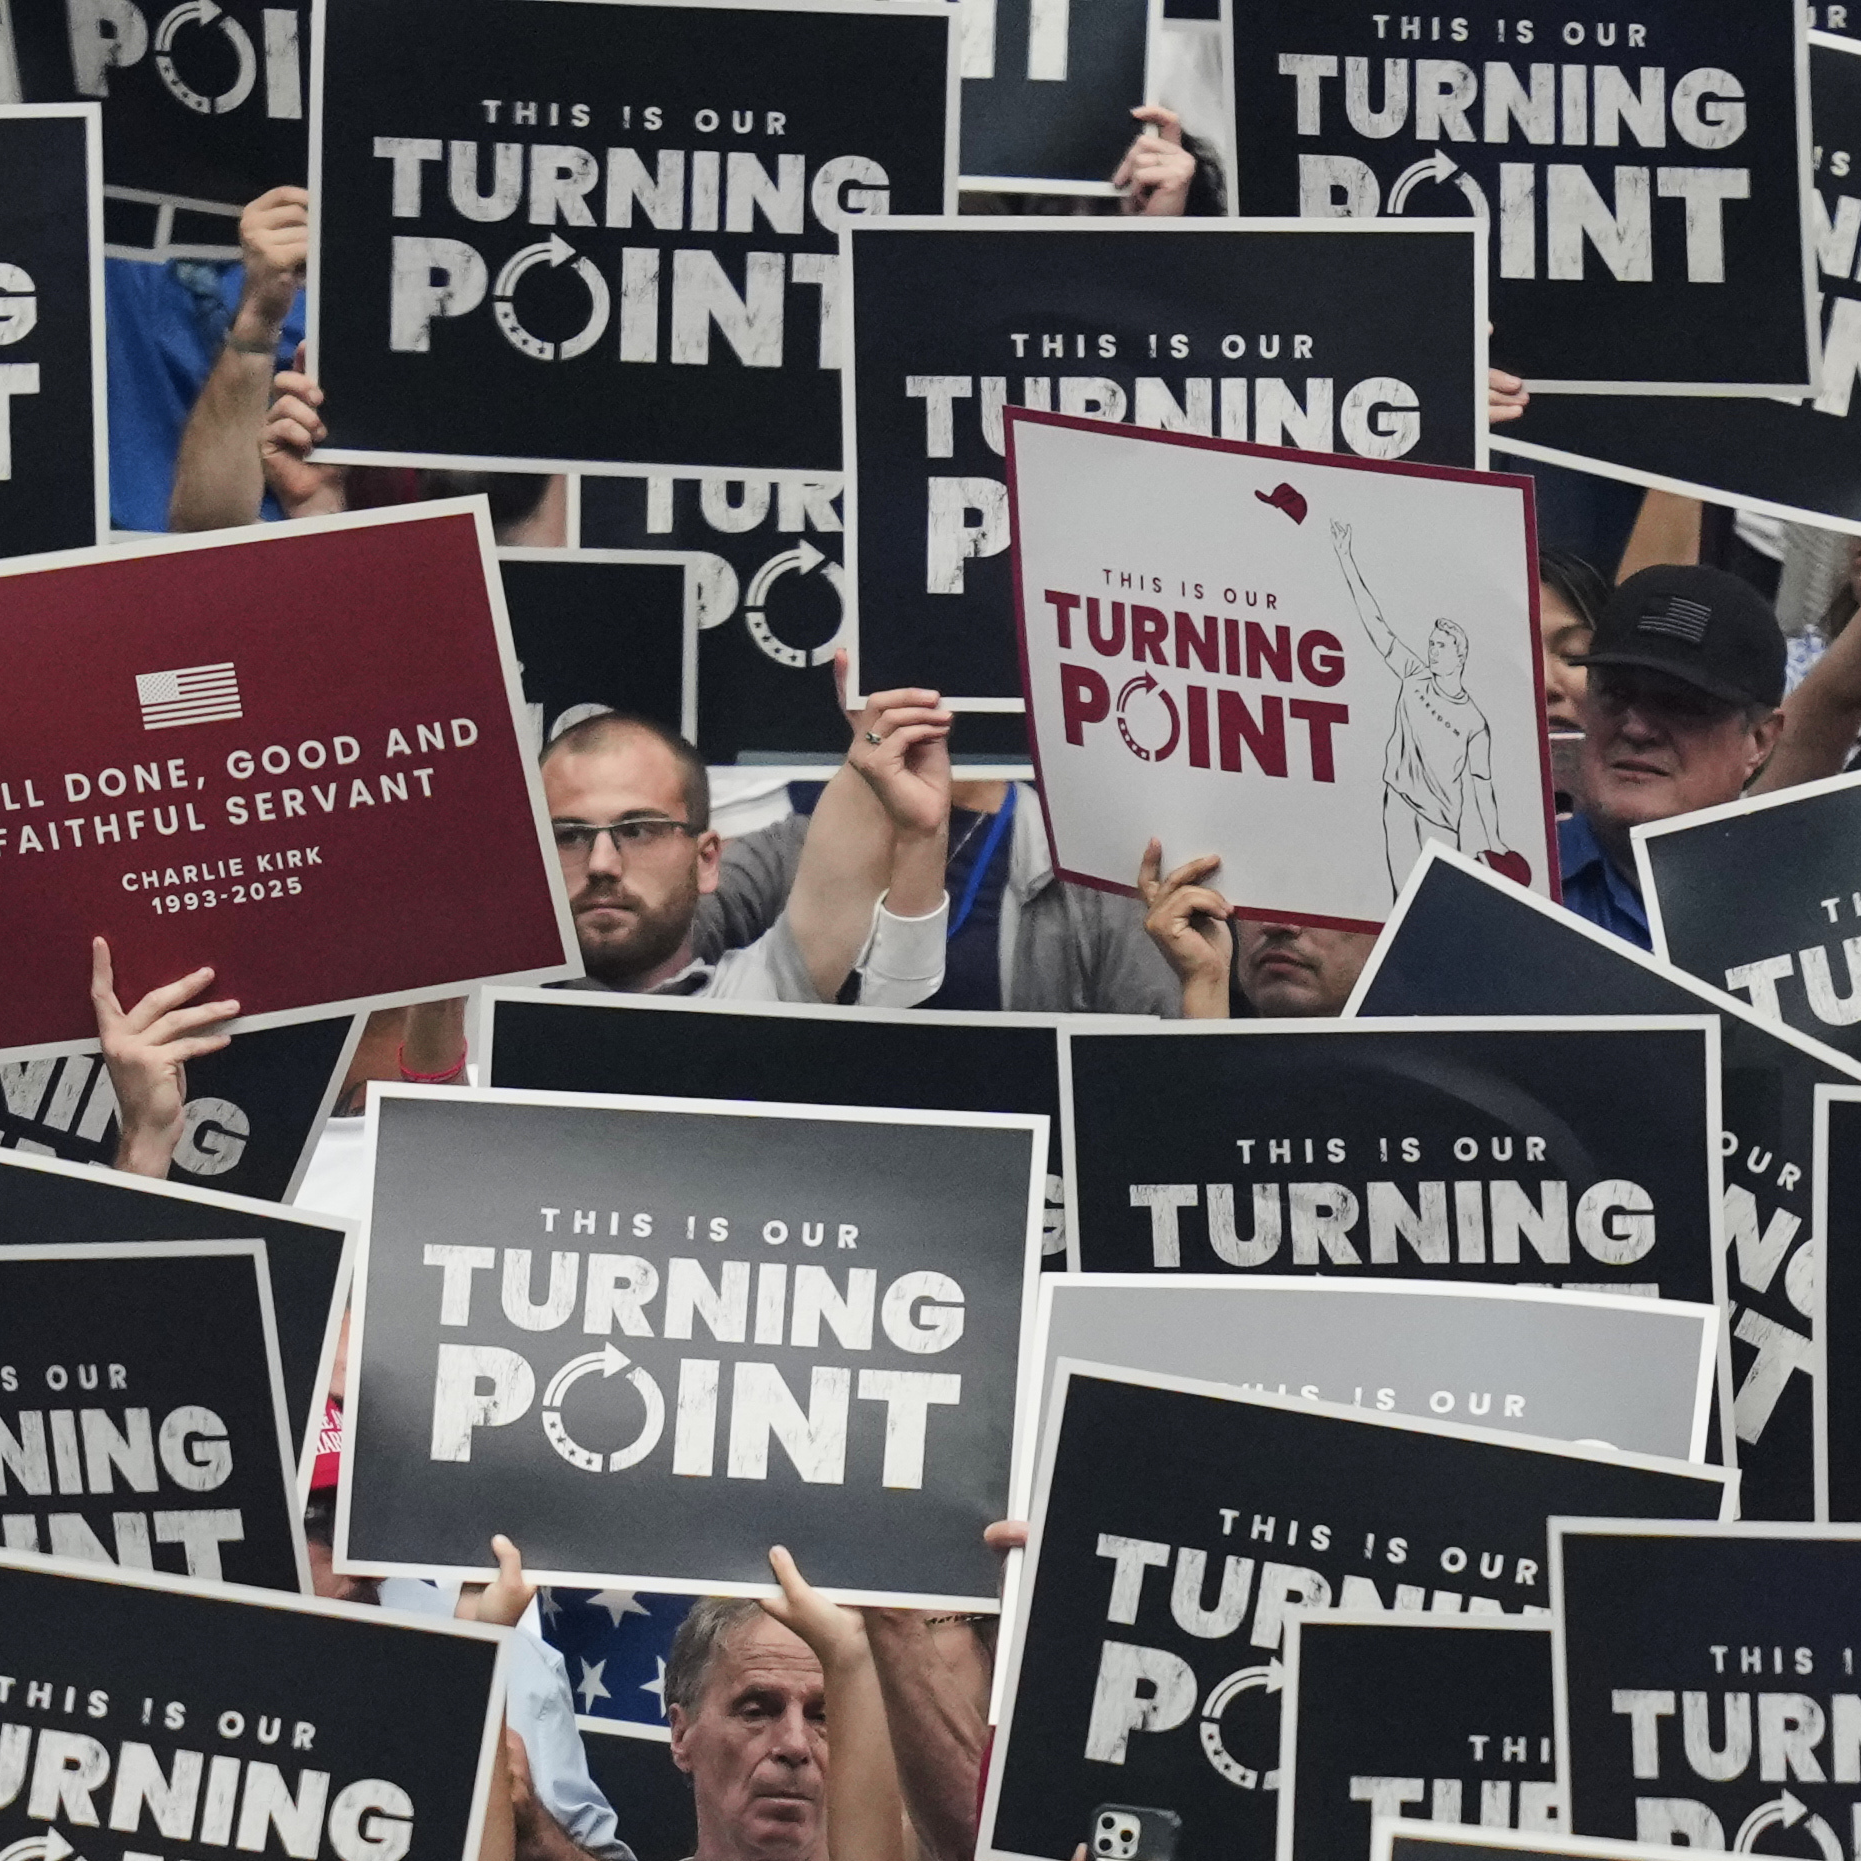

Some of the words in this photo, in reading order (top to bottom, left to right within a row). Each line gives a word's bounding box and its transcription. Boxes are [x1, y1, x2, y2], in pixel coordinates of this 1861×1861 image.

[482, 100, 590, 127] THIS
[623, 106, 662, 130] IS
[695, 109, 786, 135] OUR
[374, 137, 899, 242] TURNING
[1103, 569, 1162, 593] THIS
[1182, 581, 1203, 599] IS
[1224, 588, 1276, 610] OUR
[1045, 588, 1345, 697] TURNING
[1060, 656, 1349, 783] POINT
[65, 759, 204, 802] DONE,
[227, 736, 360, 779] GOOD
[387, 718, 477, 757] AND
[226, 768, 433, 825] SERVANT
[122, 858, 243, 891] CHARLIE
[257, 846, 322, 872] KIRK
[152, 877, 301, 914] 1993-2025
[541, 1208, 652, 1237] THIS
[687, 1216, 728, 1241] IS
[763, 1220, 858, 1248] OUR
[423, 1244, 964, 1353] TURNING
[431, 1342, 961, 1489] POINT
[1351, 1386, 1396, 1411] IS
[1430, 1391, 1525, 1417] OUR
[142, 1698, 186, 1729] IS
[218, 1711, 315, 1750] OUR
